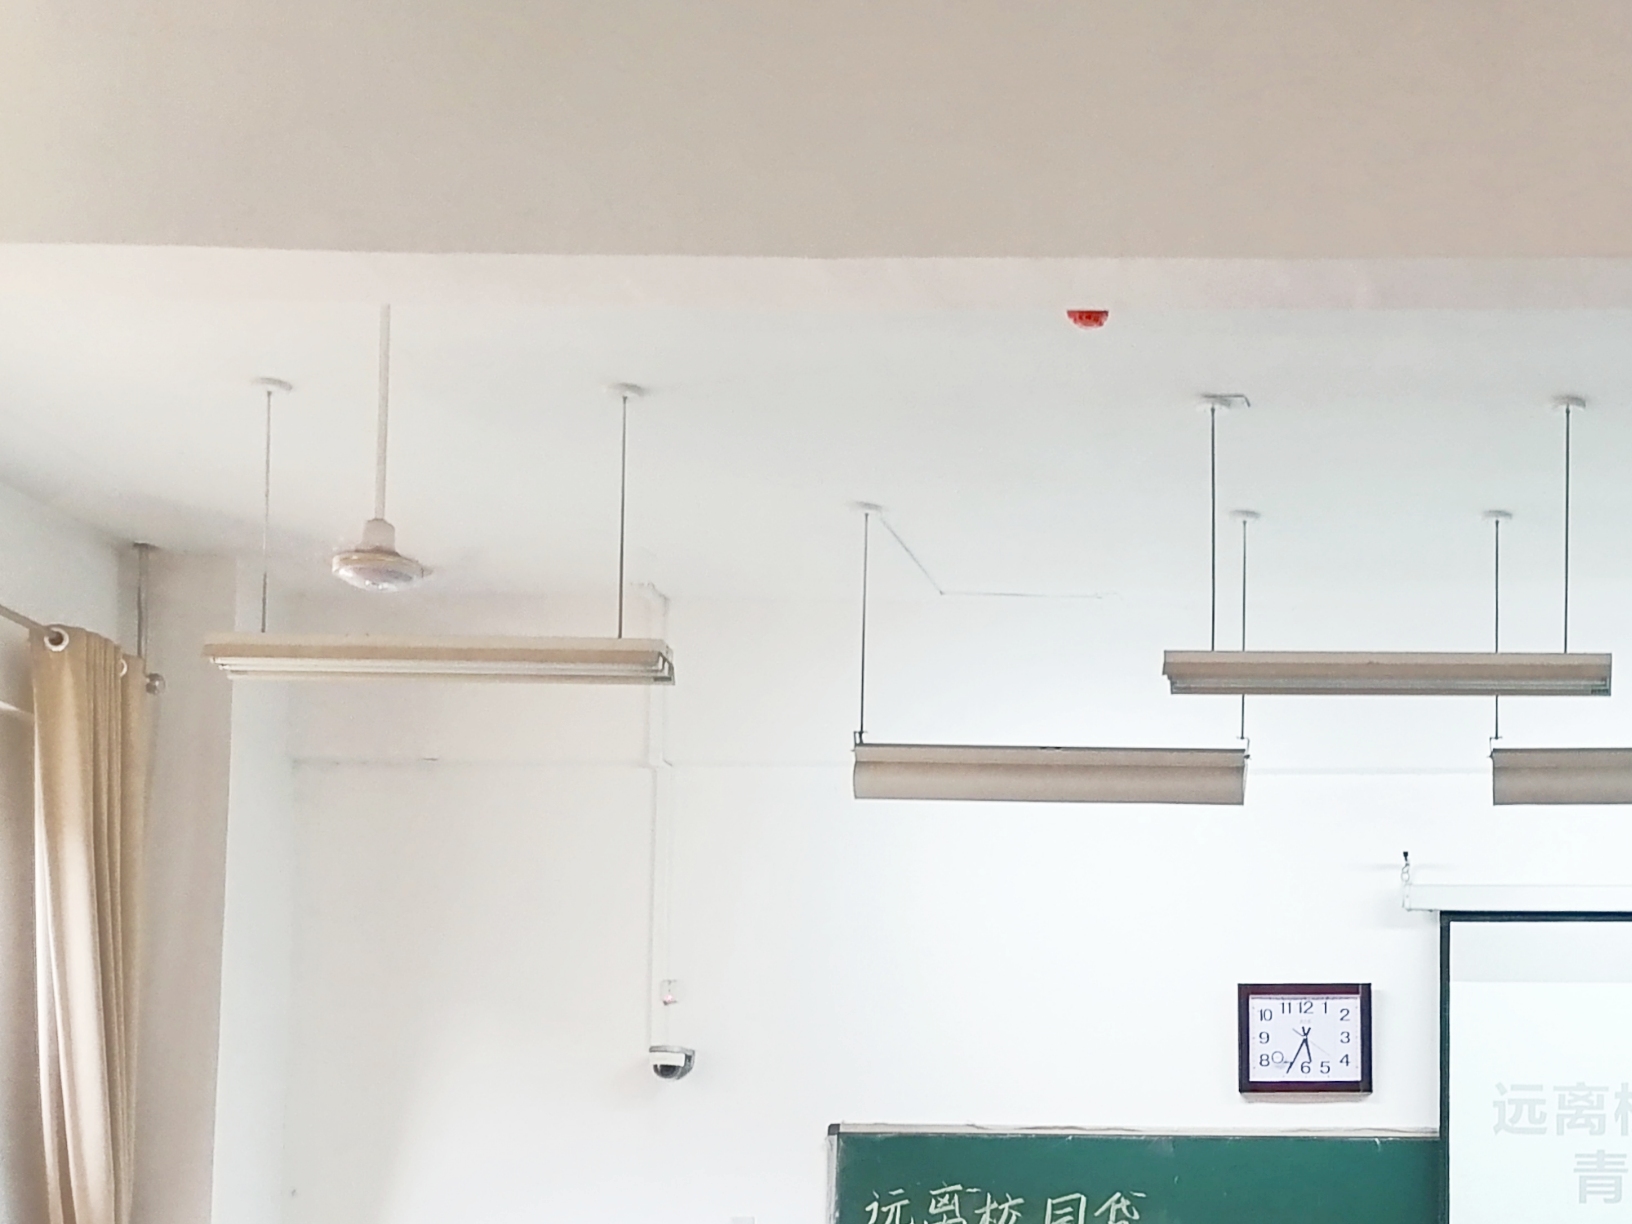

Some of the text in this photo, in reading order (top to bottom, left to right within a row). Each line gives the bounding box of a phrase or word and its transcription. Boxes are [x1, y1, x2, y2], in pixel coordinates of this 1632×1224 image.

[1280, 1001, 1292, 1014] 11
[1298, 1001, 1314, 1014] 12
[1259, 1008, 1273, 1021] 10
[1339, 1008, 1350, 1021] 2
[1258, 1031, 1270, 1044] 9
[1339, 1031, 1350, 1044] 3
[1259, 1054, 1270, 1067] 8
[1339, 1054, 1351, 1067] 4
[1300, 1061, 1311, 1074] 6
[1319, 1061, 1331, 1074] 5
